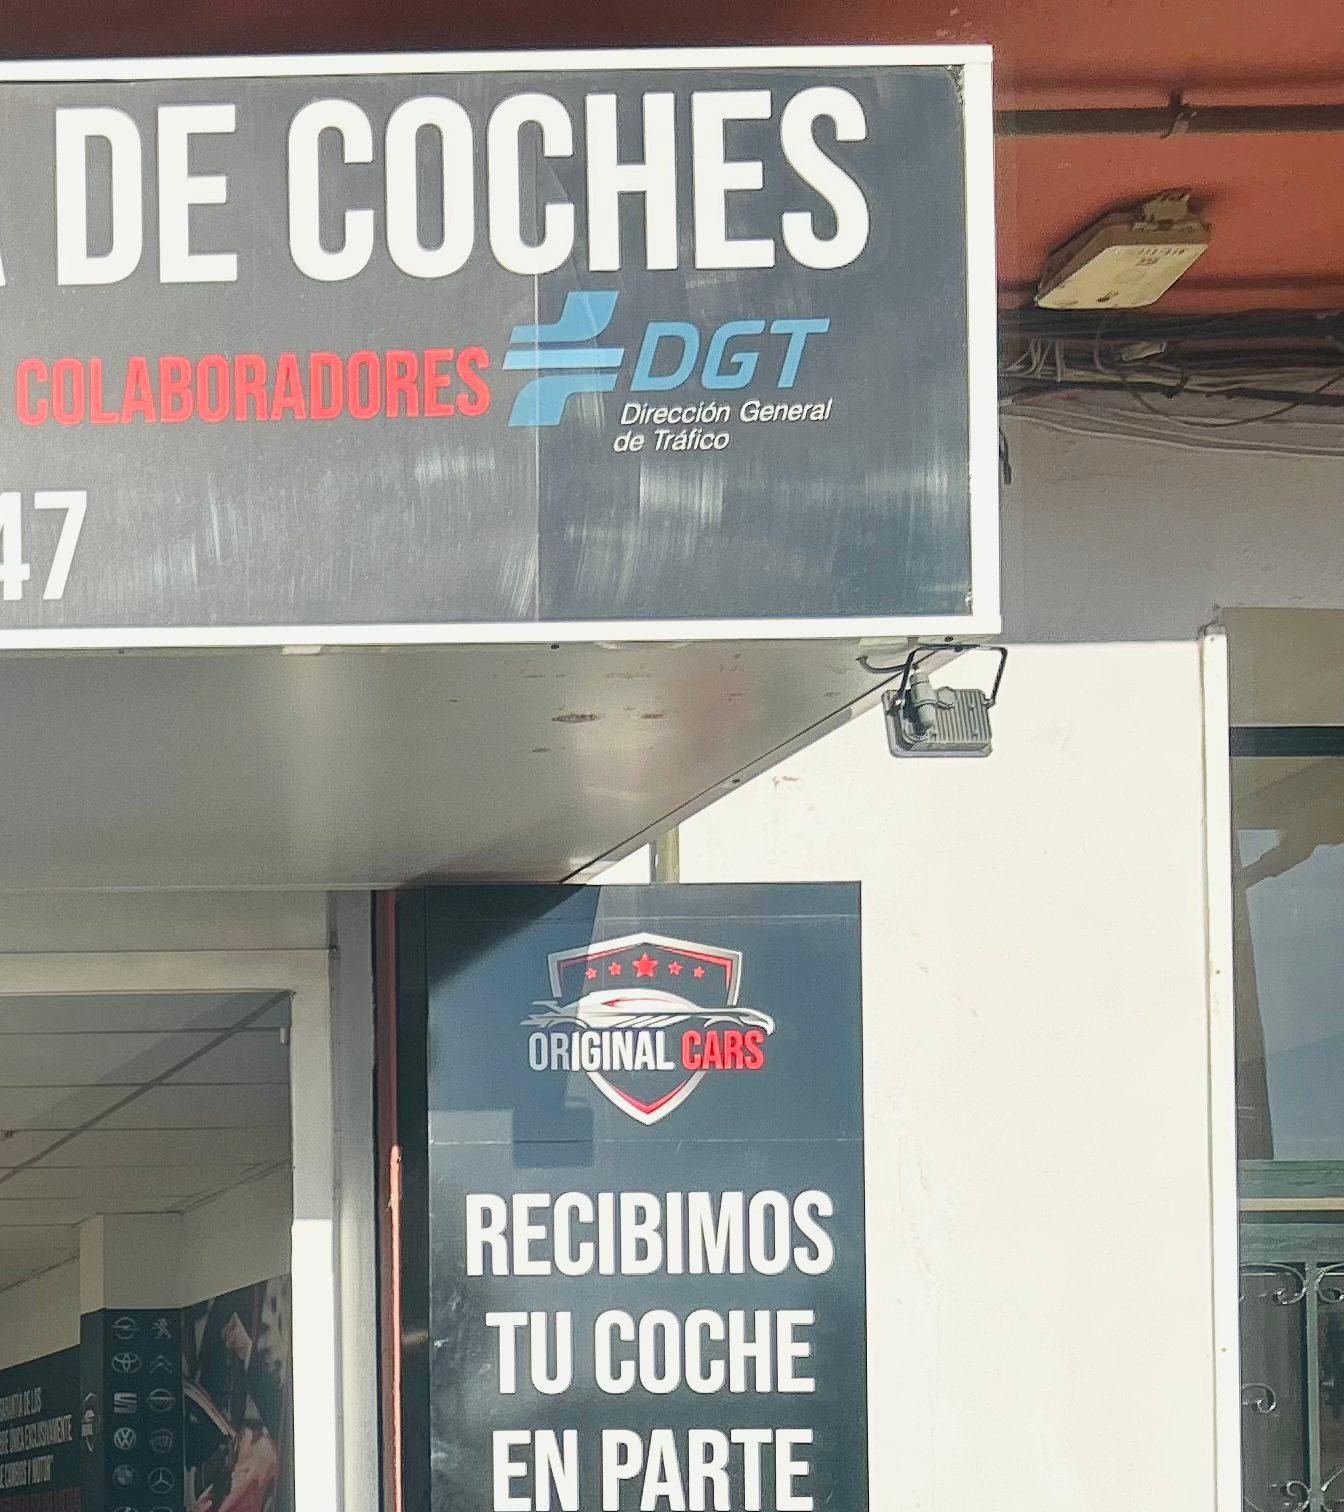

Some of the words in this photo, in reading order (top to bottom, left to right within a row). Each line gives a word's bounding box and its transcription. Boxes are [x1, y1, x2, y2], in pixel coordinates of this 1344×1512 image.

[55, 103, 238, 287] DE
[287, 86, 870, 282] COCHES
[16, 347, 492, 427] COLABORADORES
[630, 319, 831, 392] DGT
[613, 430, 646, 452] de
[654, 429, 731, 453] Tráfico
[620, 398, 732, 426] Dirección
[739, 398, 834, 423] General
[528, 1030, 675, 1072] ORIGINAL
[681, 1030, 766, 1071] CARS
[466, 1191, 834, 1277] RECIBIMOS
[486, 1311, 573, 1396] TU
[594, 1310, 816, 1395] COCHE
[493, 1430, 580, 1512] EN
[603, 1430, 815, 1512] PARTE
